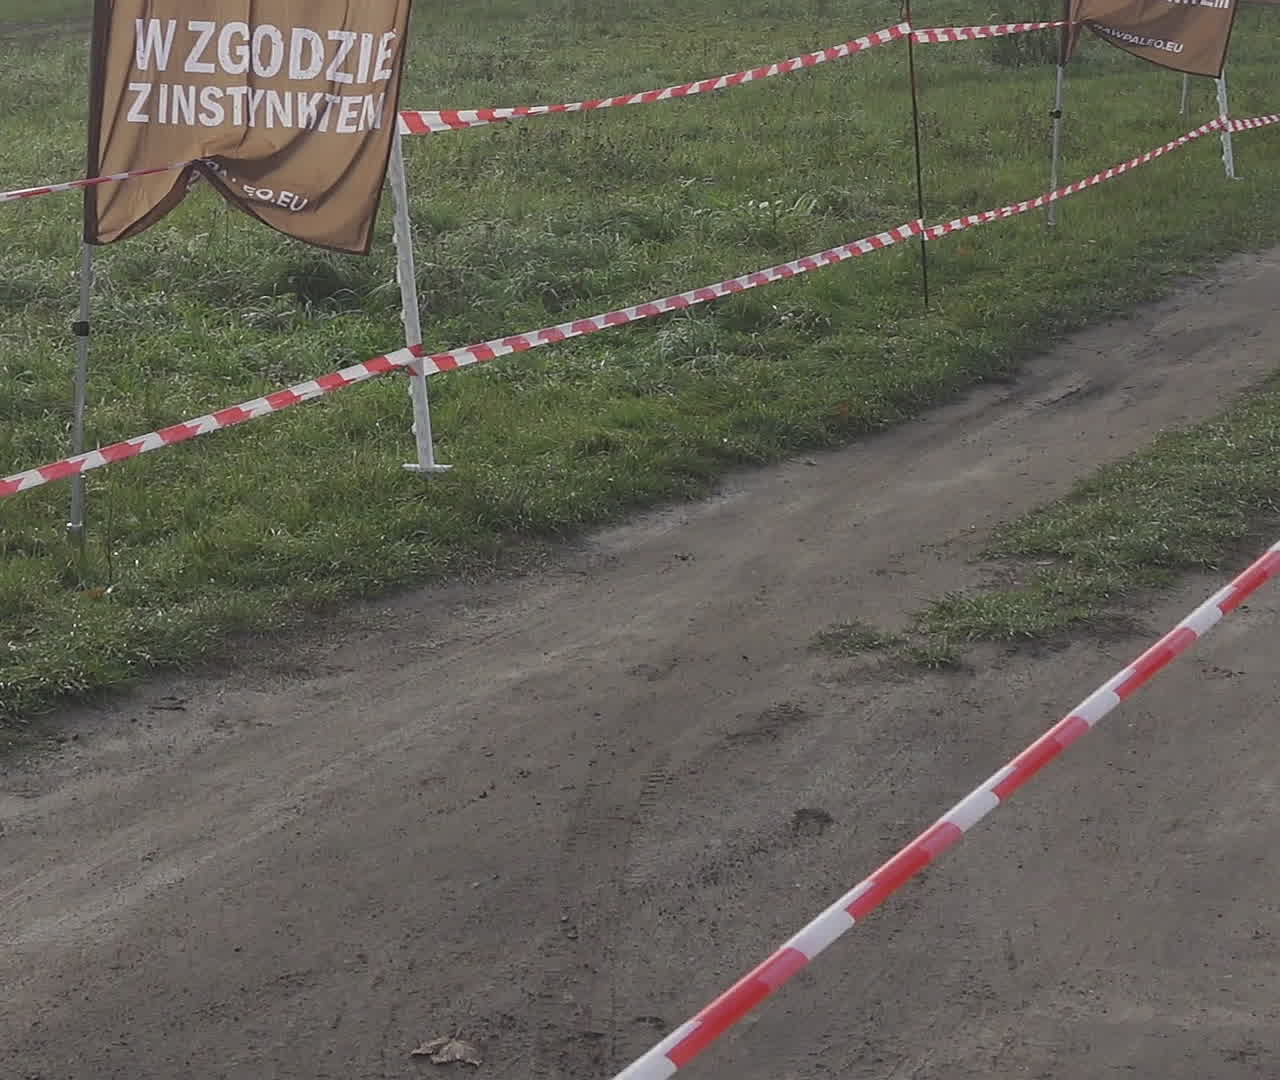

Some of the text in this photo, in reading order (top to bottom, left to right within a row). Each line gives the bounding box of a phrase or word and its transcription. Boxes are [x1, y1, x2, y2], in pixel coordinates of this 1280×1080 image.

[135, 18, 401, 85] W ZGODZIE
[126, 82, 387, 135] Z INSTYNKTEM
